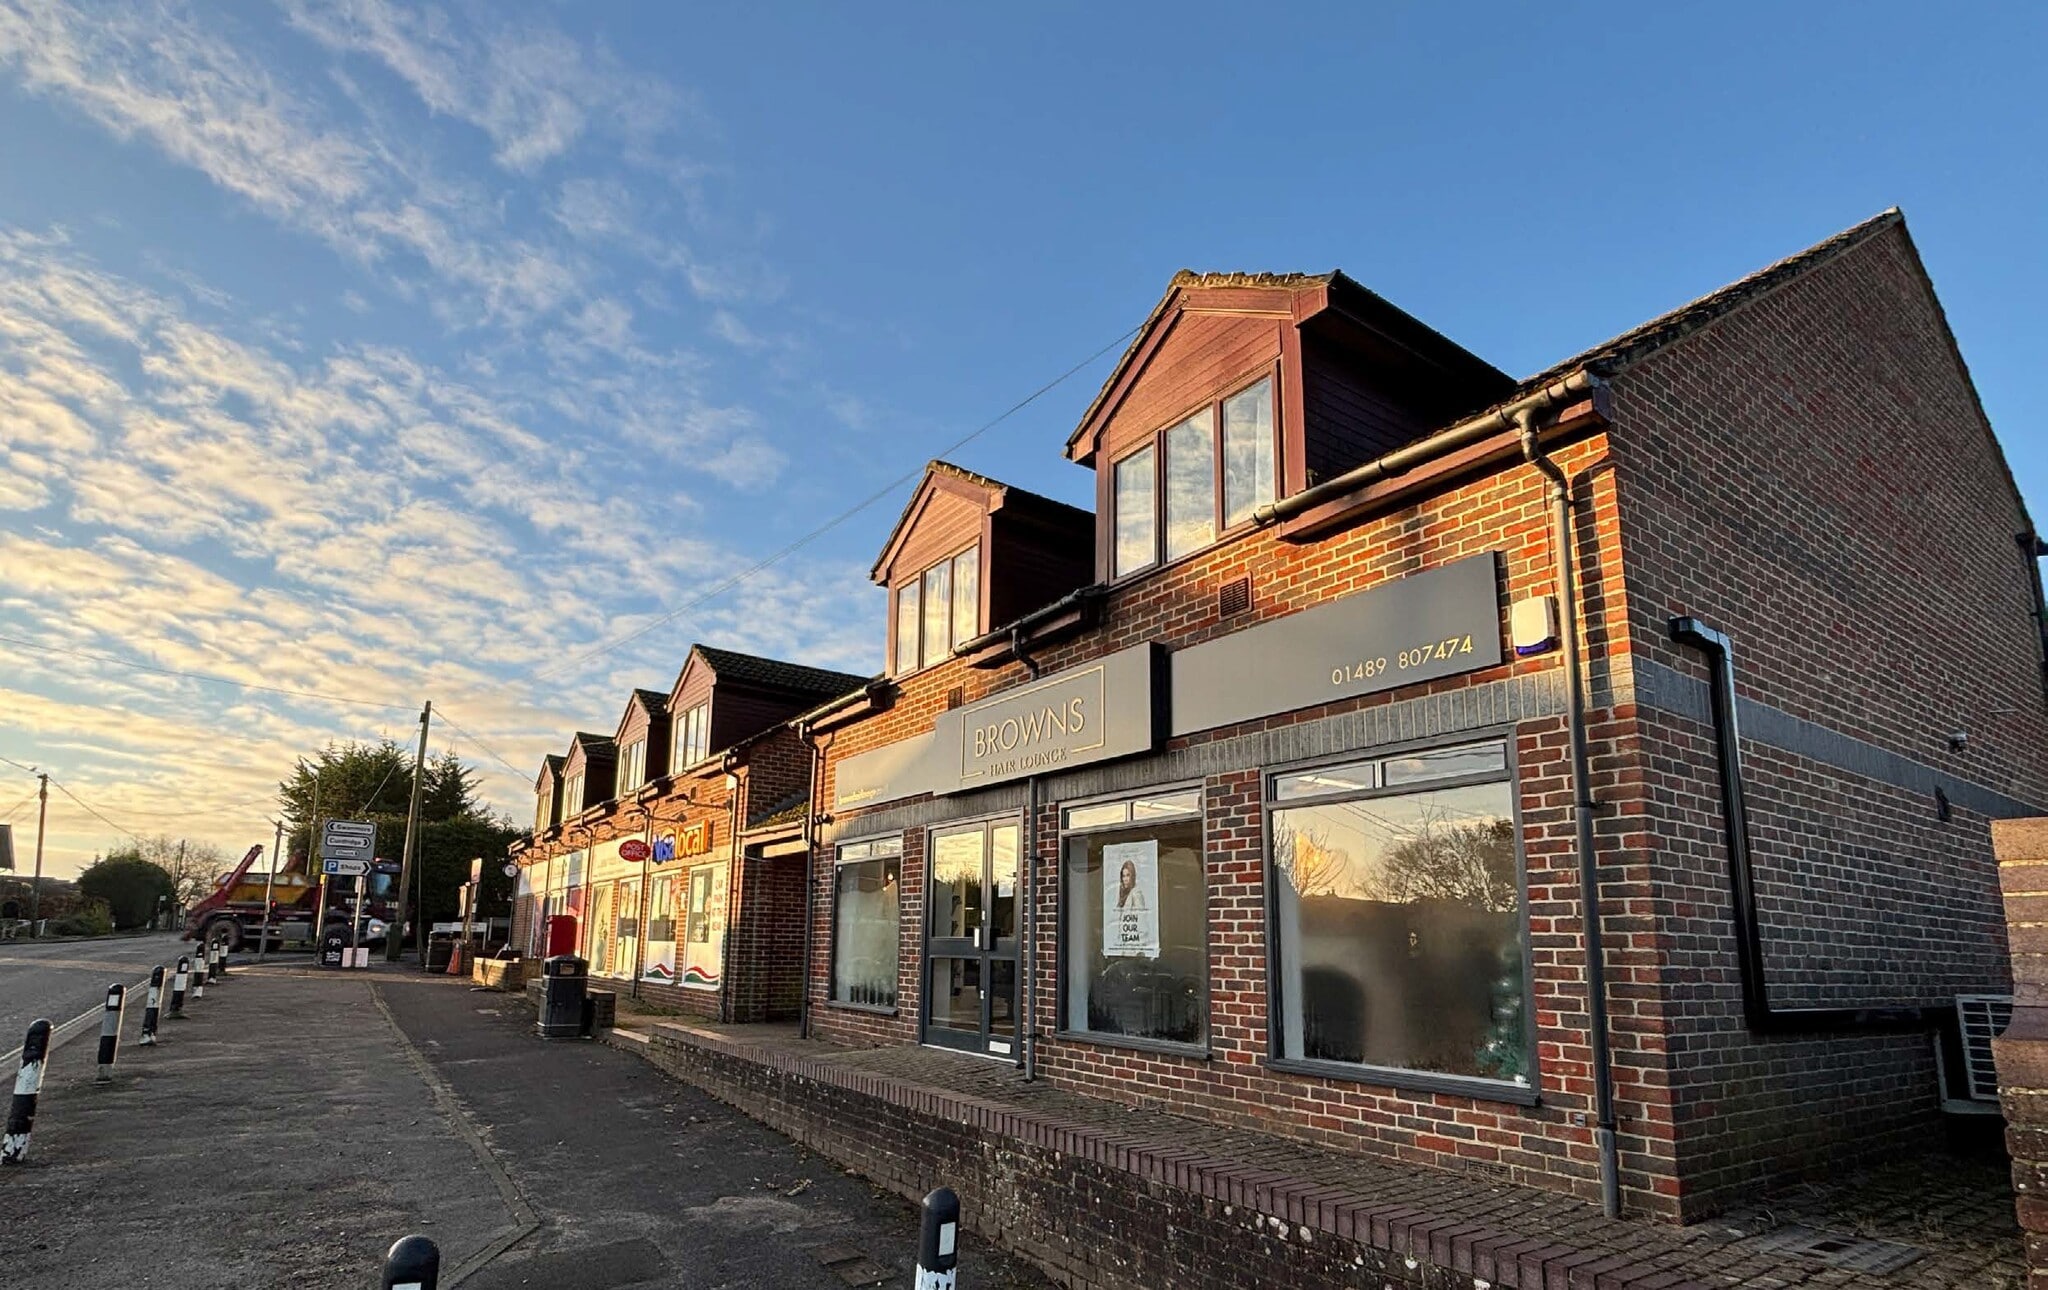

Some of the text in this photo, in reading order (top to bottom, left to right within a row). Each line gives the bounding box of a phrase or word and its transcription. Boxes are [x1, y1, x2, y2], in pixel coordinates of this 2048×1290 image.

[1332, 634, 1473, 685] 01489 807474
[975, 697, 1085, 758] BROWNS
[990, 747, 1068, 777] HAIR LOUNGE
[626, 842, 645, 850] POST
[621, 849, 648, 858] OFFICE
[328, 861, 337, 871] P
[1122, 914, 1138, 923] JOIN
[1122, 924, 1138, 932] OUR
[1120, 933, 1140, 942] TEAM
